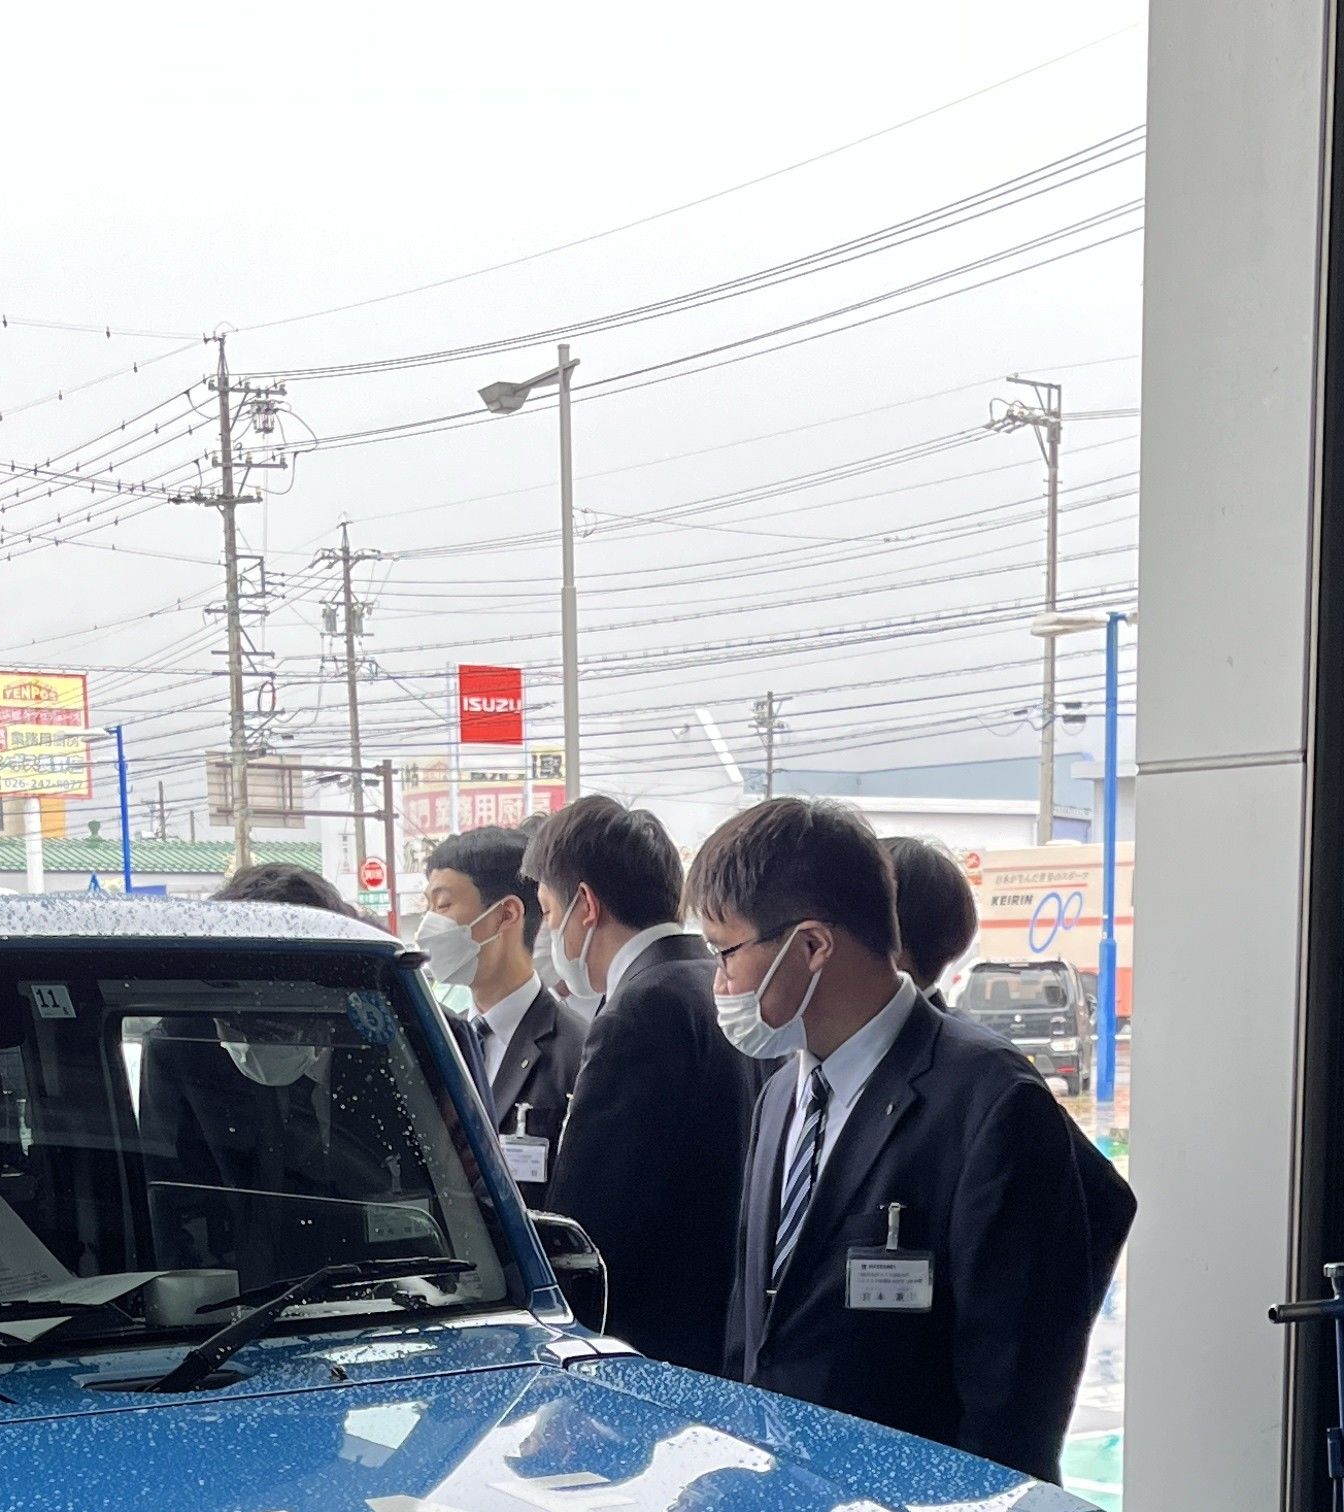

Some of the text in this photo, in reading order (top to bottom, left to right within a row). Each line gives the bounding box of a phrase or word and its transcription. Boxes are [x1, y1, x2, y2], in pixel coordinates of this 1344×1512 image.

[463, 697, 522, 713] ISUZU
[990, 894, 1033, 906] KEIRIN
[36, 989, 60, 1008] 11
